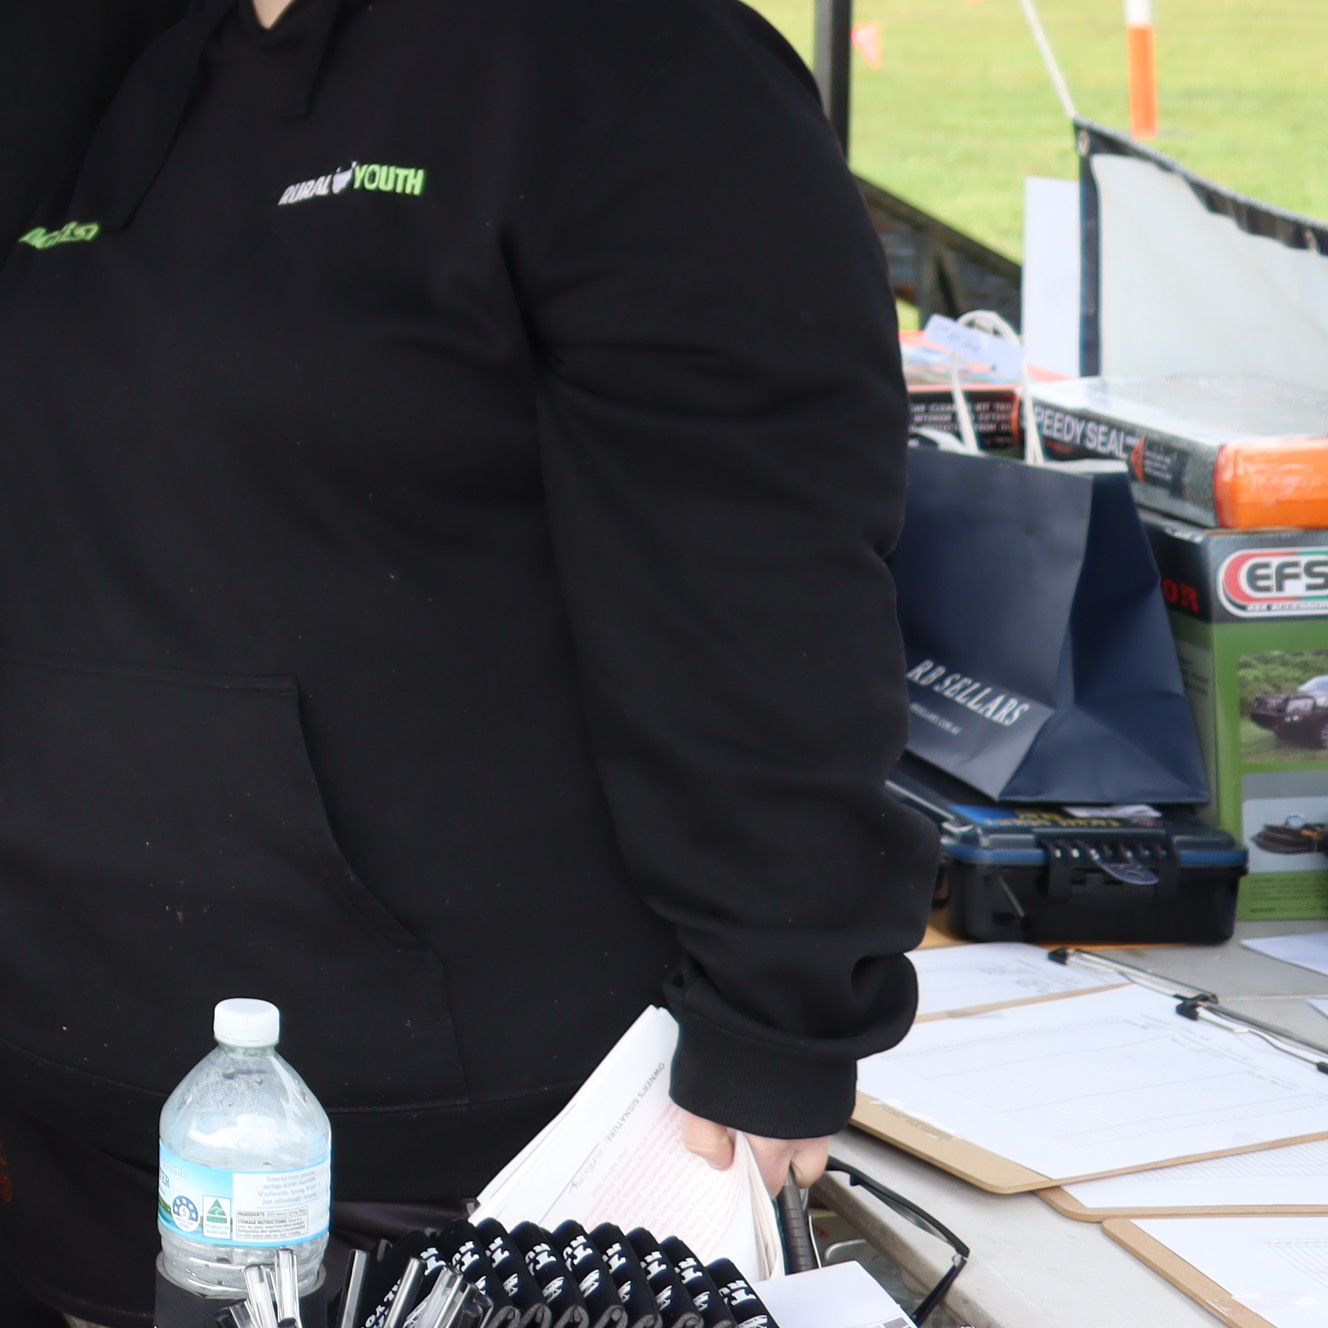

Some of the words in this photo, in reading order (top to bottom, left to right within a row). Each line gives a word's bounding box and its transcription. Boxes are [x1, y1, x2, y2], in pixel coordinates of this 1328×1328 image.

[278, 174, 333, 206] RURAL
[354, 164, 425, 196] YOUTH
[1087, 424, 1129, 459] SEAL
[1246, 560, 1328, 593] EFS
[933, 673, 1031, 727] SELLARS
